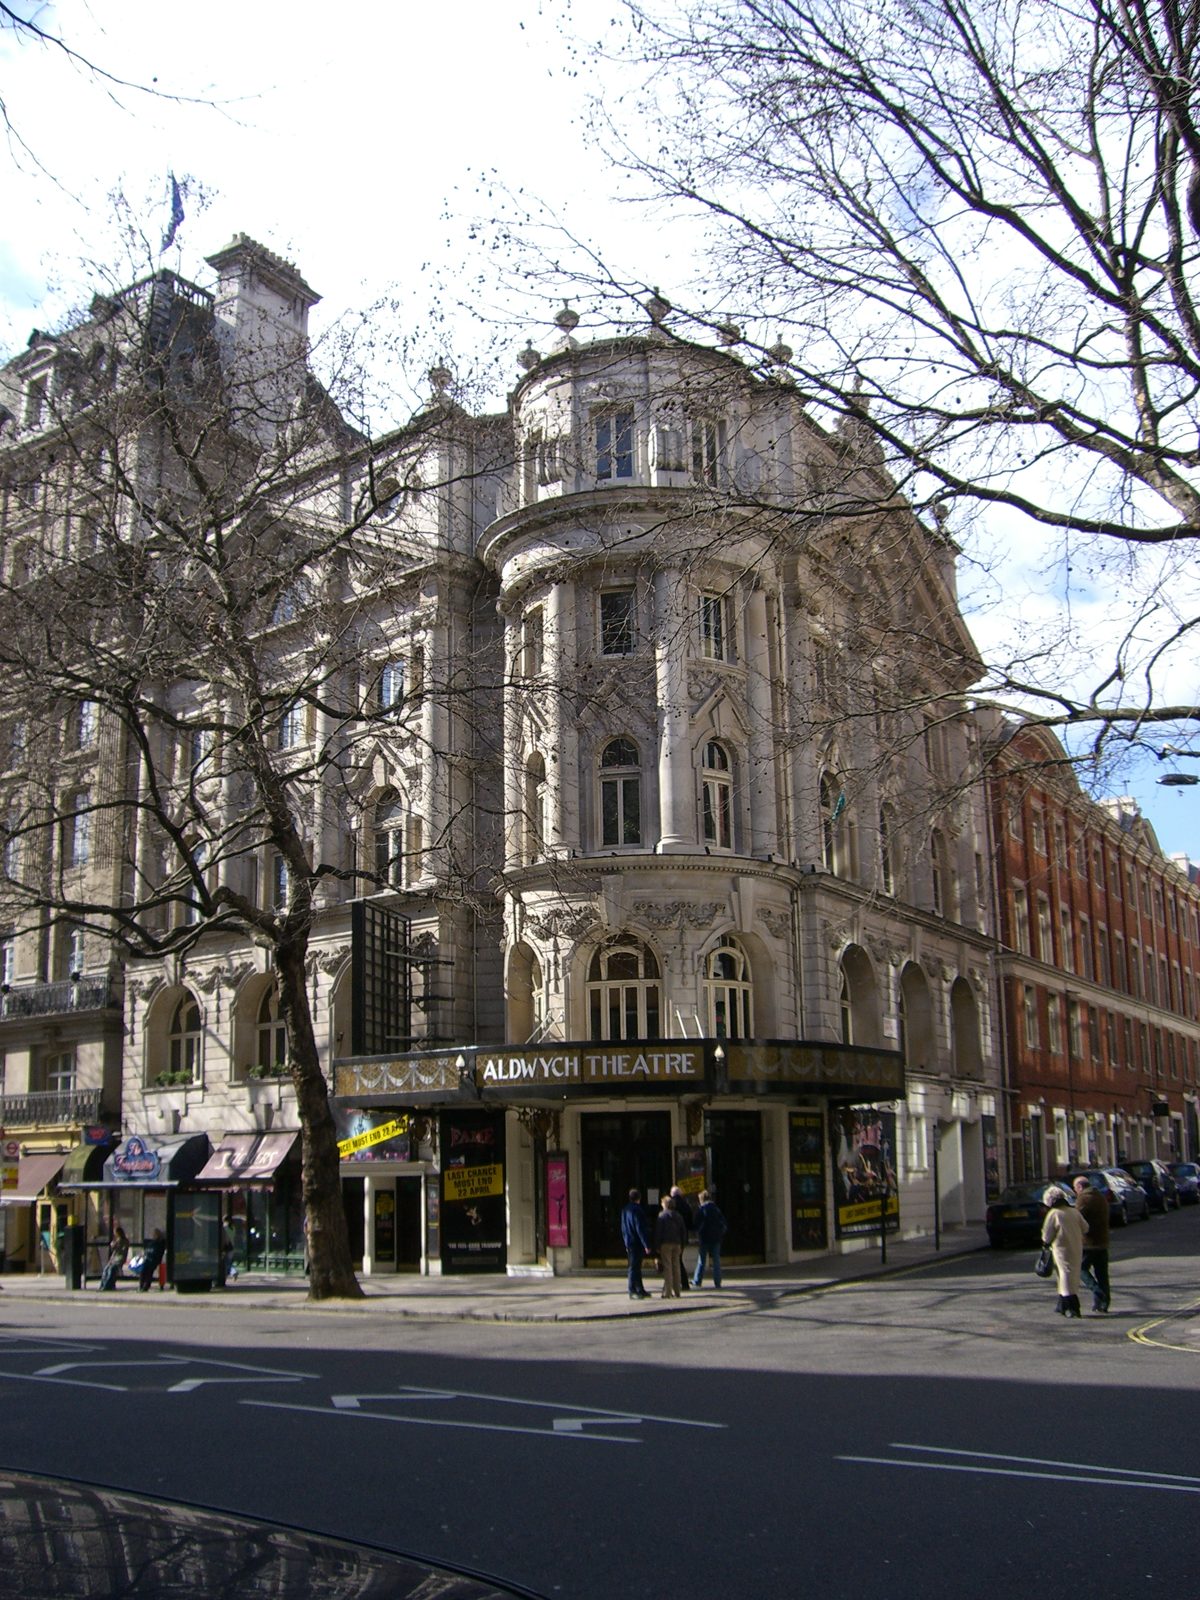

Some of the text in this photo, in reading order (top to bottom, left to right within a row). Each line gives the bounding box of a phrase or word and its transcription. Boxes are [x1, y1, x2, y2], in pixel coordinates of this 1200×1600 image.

[483, 1053, 696, 1080] ALDWYCH THEATRE
[352, 1135, 368, 1148] MUST
[369, 1131, 381, 1142] END
[382, 1127, 390, 1137] 22
[450, 1126, 495, 1147] FAME
[447, 1167, 497, 1181] LAST CHANCE
[454, 1177, 493, 1188] MUST END
[457, 1186, 491, 1197] 22 APRIL
